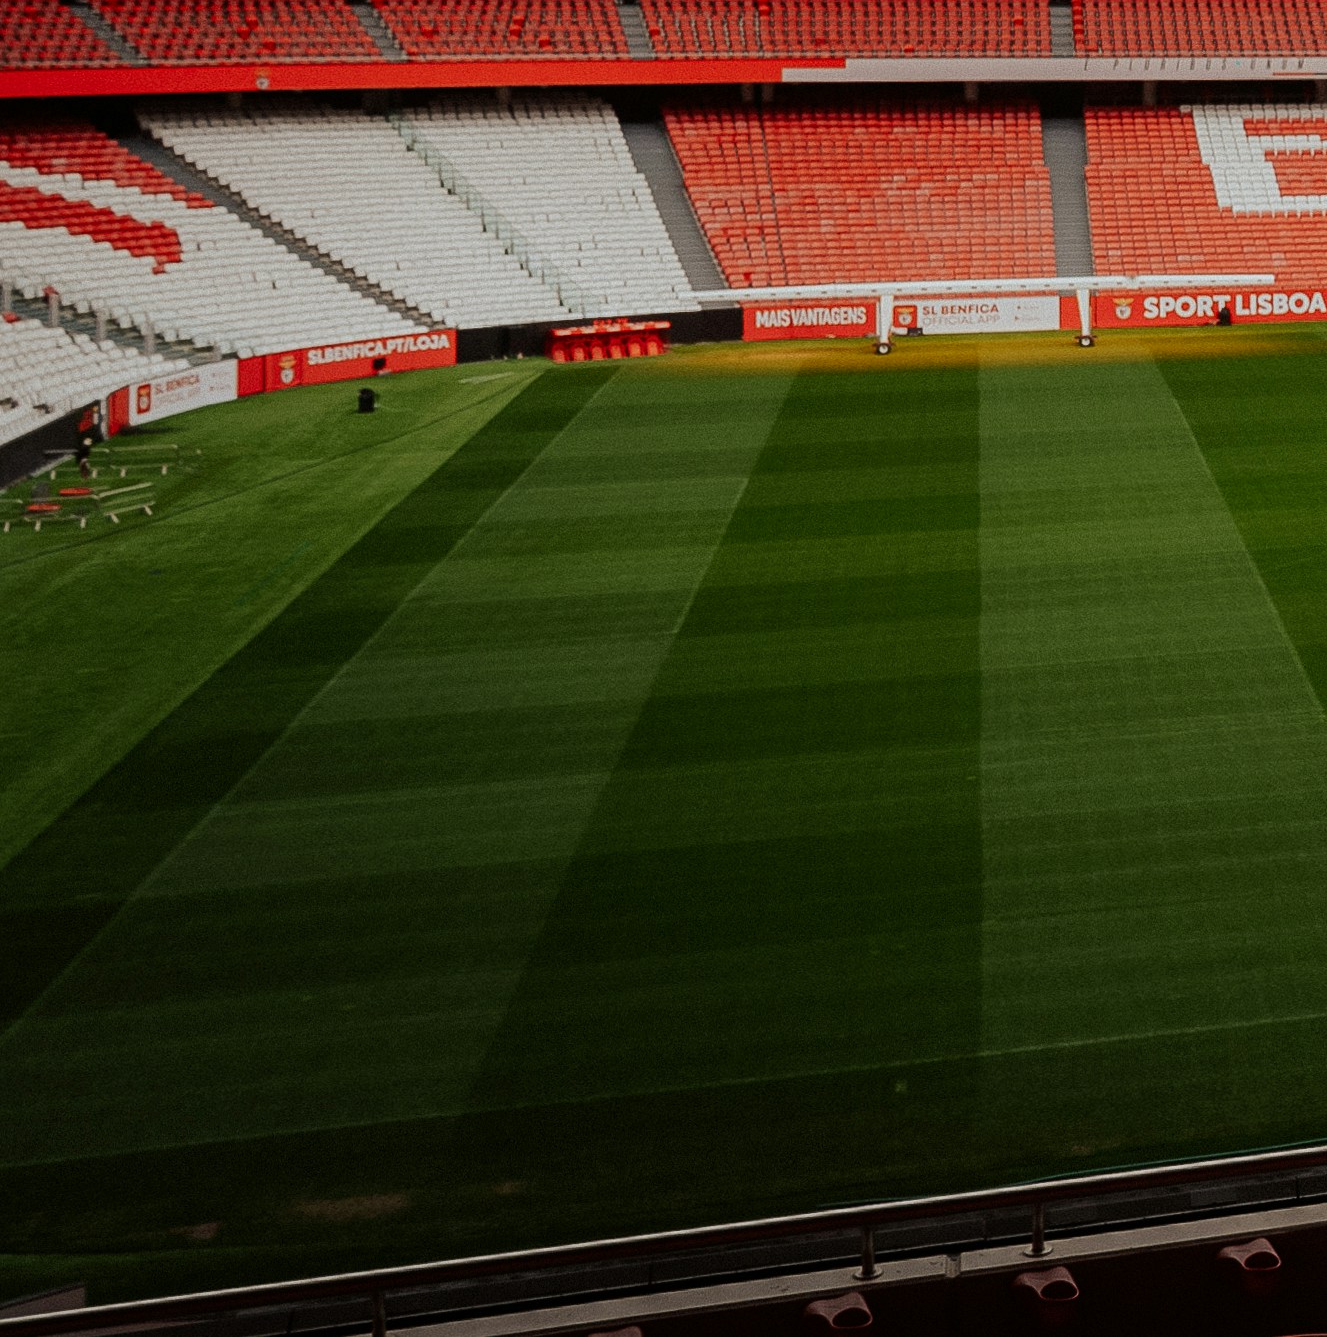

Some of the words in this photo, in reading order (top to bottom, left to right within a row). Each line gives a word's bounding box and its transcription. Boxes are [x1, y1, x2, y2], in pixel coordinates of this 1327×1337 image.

[755, 308, 791, 329] MAIS
[791, 306, 867, 326] VANTAGENS
[922, 305, 938, 316] SL
[941, 303, 999, 315] BENFICA
[1143, 294, 1232, 319] SPORT
[1235, 292, 1327, 316] LISBOA
[307, 333, 451, 366] SLBENFICA.PT/LOJA
